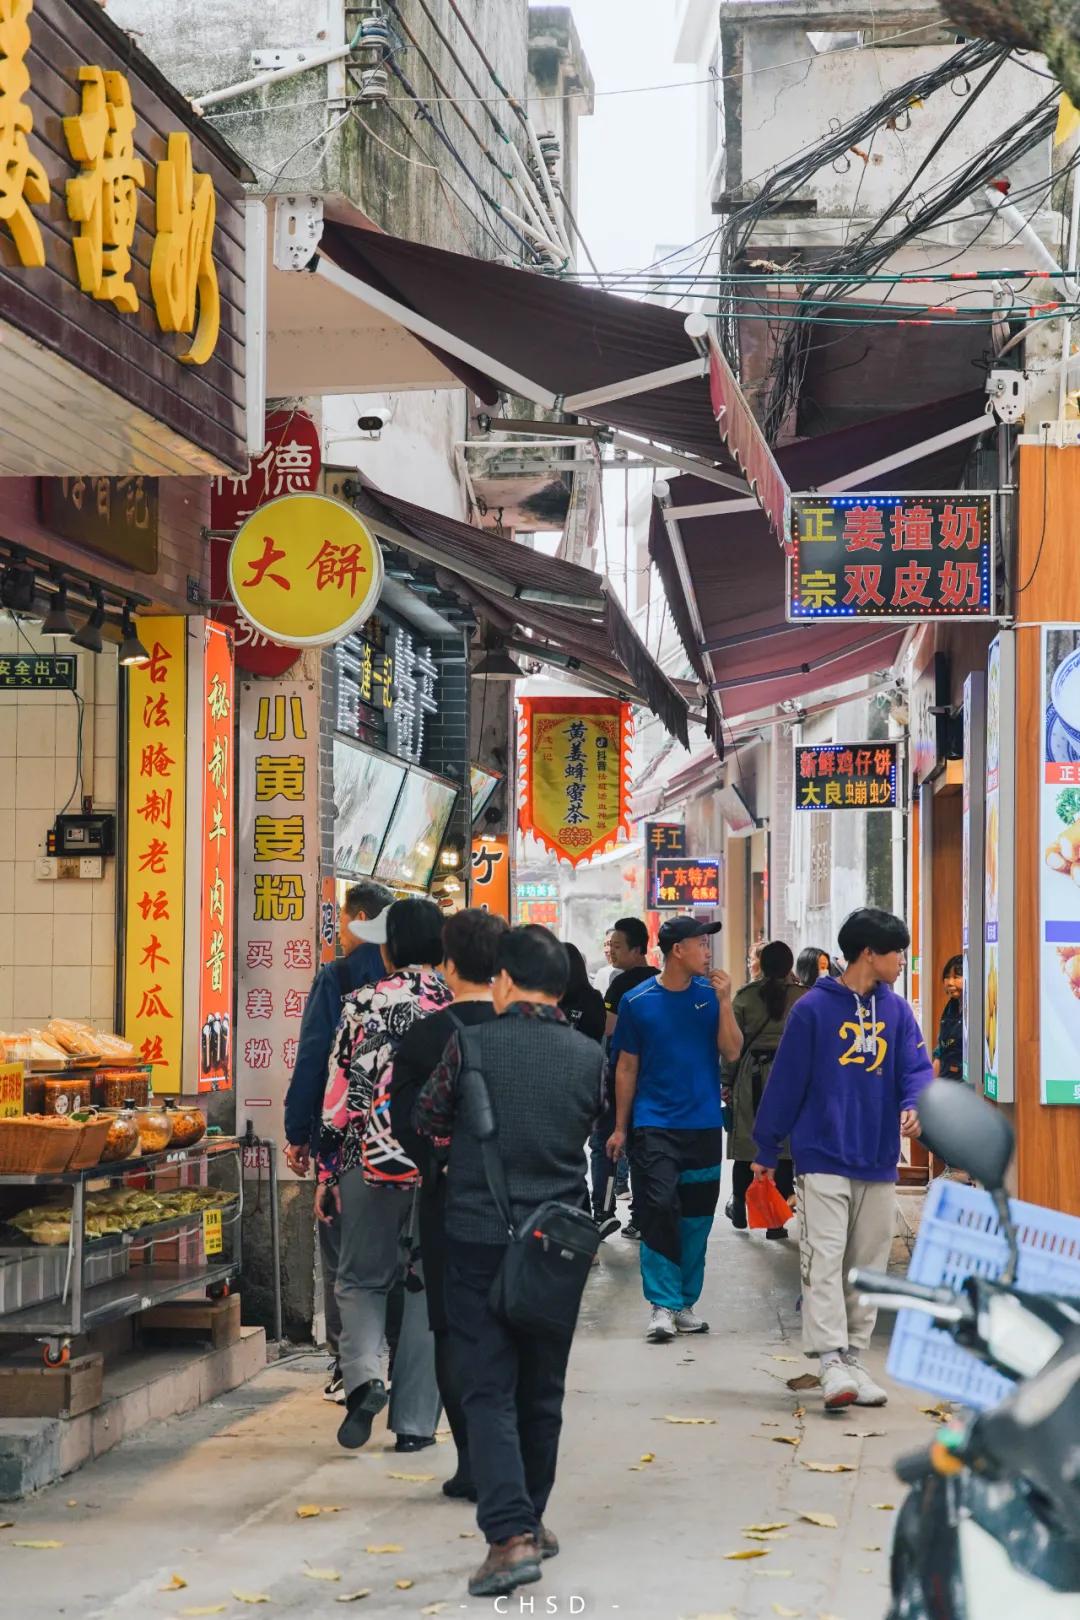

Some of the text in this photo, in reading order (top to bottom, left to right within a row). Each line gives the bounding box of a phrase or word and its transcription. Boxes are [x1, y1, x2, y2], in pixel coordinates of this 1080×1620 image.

[843, 505, 981, 552] 姜撞奶
[842, 560, 981, 607] 双皮奶
[0, 660, 69, 676] 安全出口
[562, 720, 589, 824] 黄姜蜂蜜茶
[800, 749, 891, 778] 新鲜鸡仔饼
[253, 695, 307, 922] 小黄姜粉
[136, 641, 176, 1066] 古法腌制老坛木瓜丝
[651, 828, 682, 850] 手工
[660, 867, 717, 886] 广东特产
